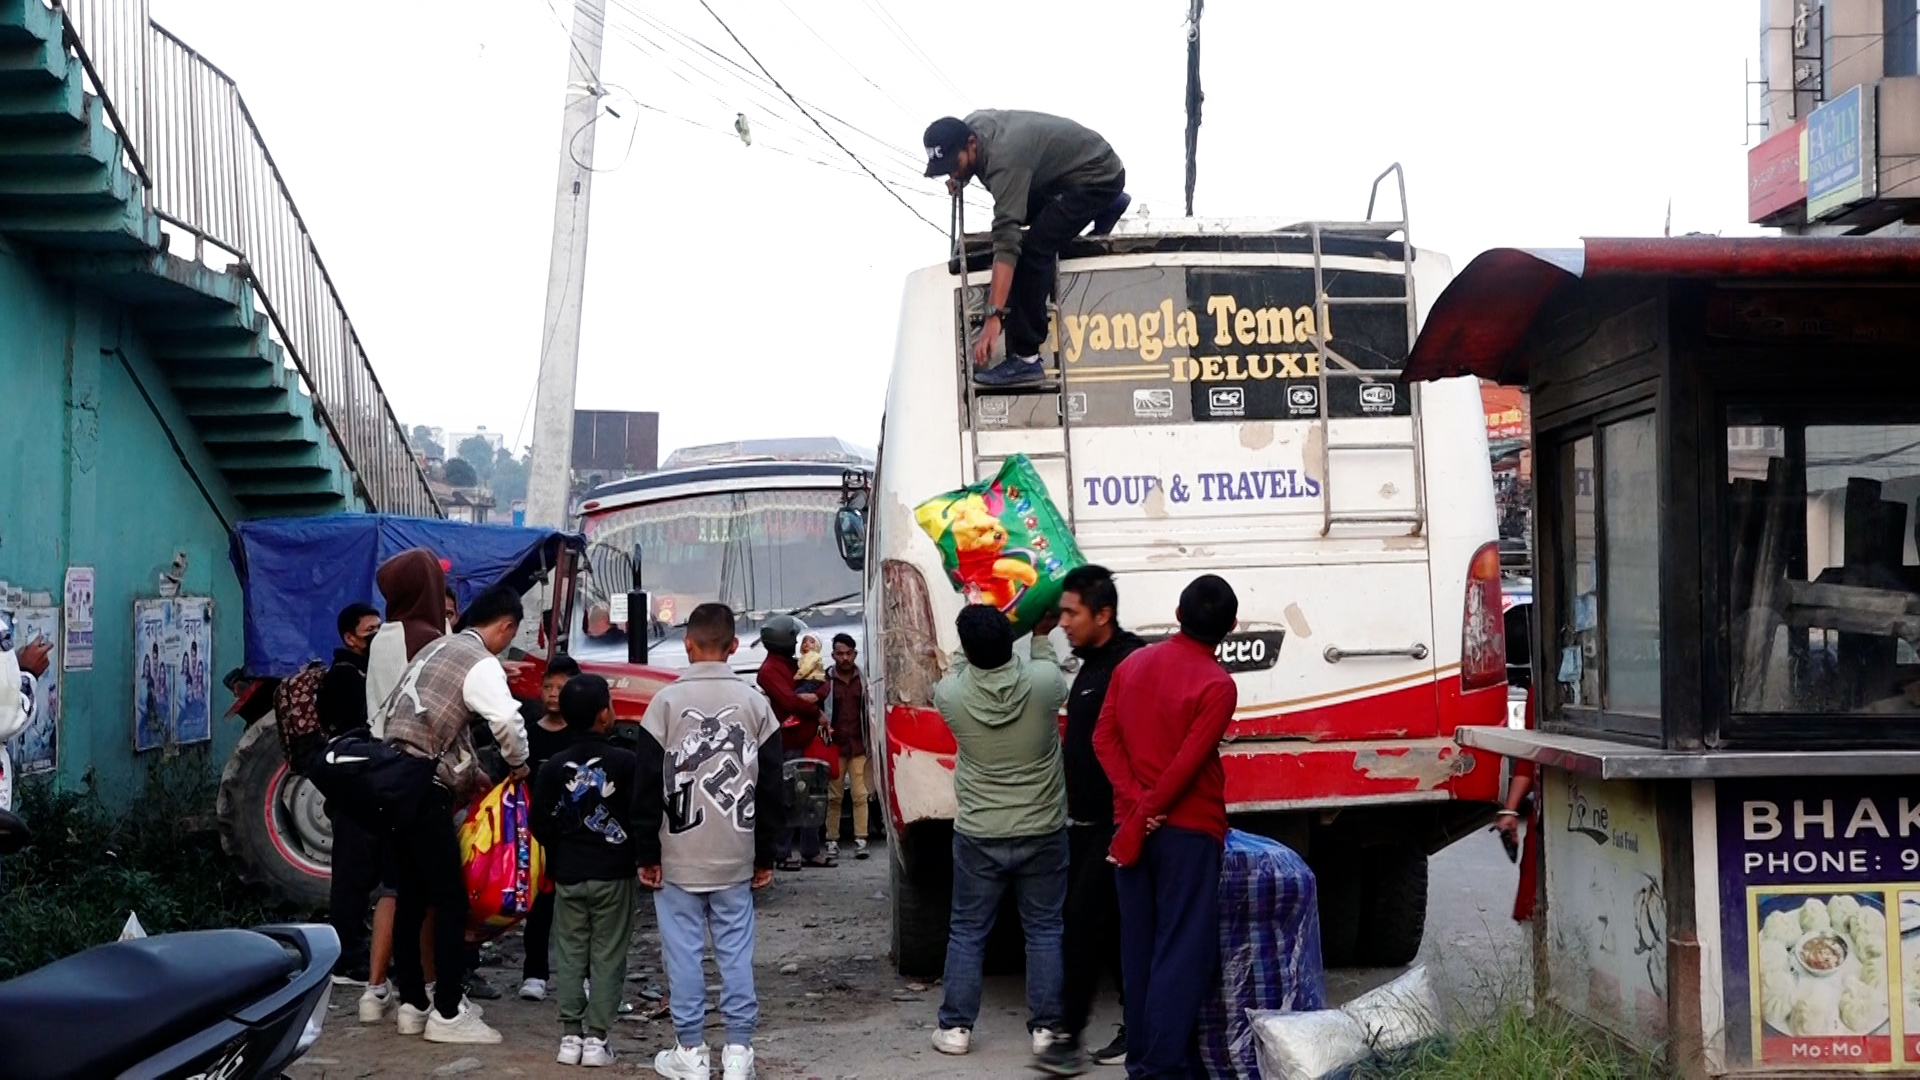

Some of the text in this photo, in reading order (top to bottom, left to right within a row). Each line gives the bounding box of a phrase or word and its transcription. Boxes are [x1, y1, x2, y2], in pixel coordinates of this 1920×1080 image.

[1171, 353, 1320, 382] DELUXE
[1170, 473, 1191, 503] &
[1198, 469, 1321, 502] TRAVELS
[1744, 849, 1881, 875] PHONE:
